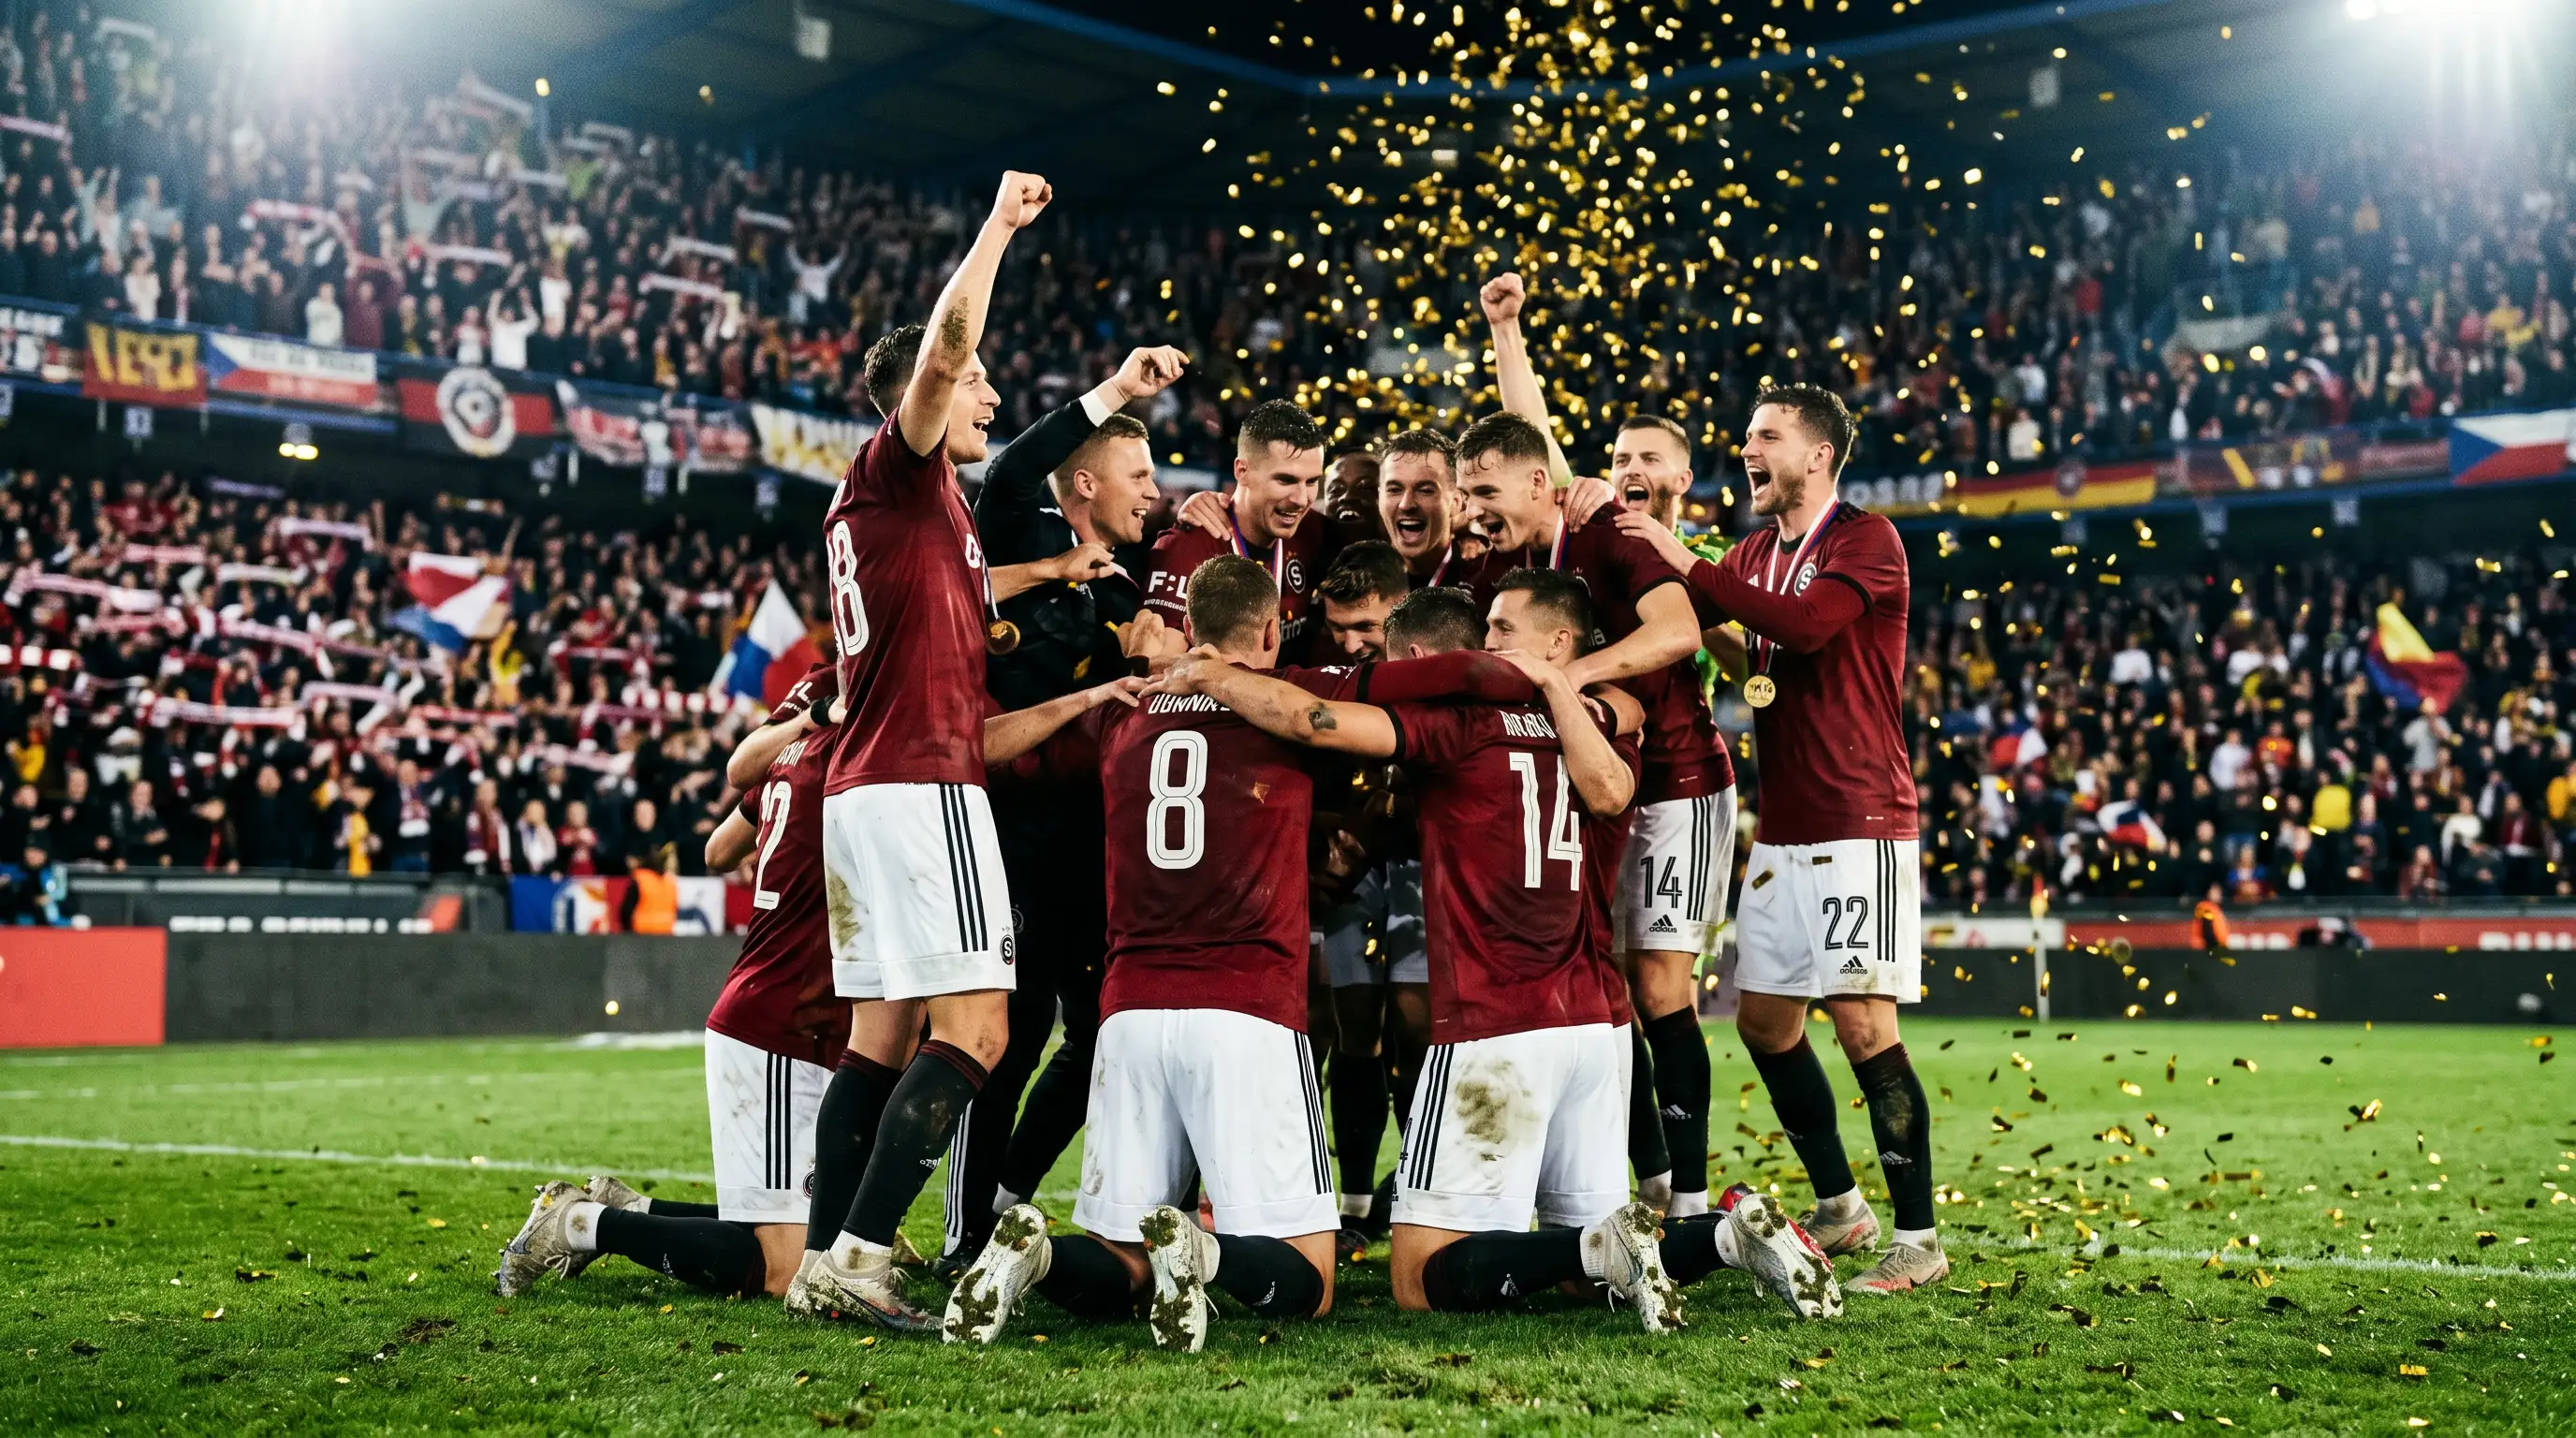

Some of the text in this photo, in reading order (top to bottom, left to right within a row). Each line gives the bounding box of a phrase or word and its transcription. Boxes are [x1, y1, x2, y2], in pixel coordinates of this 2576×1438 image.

[1147, 729, 1208, 870] 8
[1508, 752, 1583, 892] 14
[1640, 856, 1683, 908] 14
[1822, 895, 1869, 950] 22
